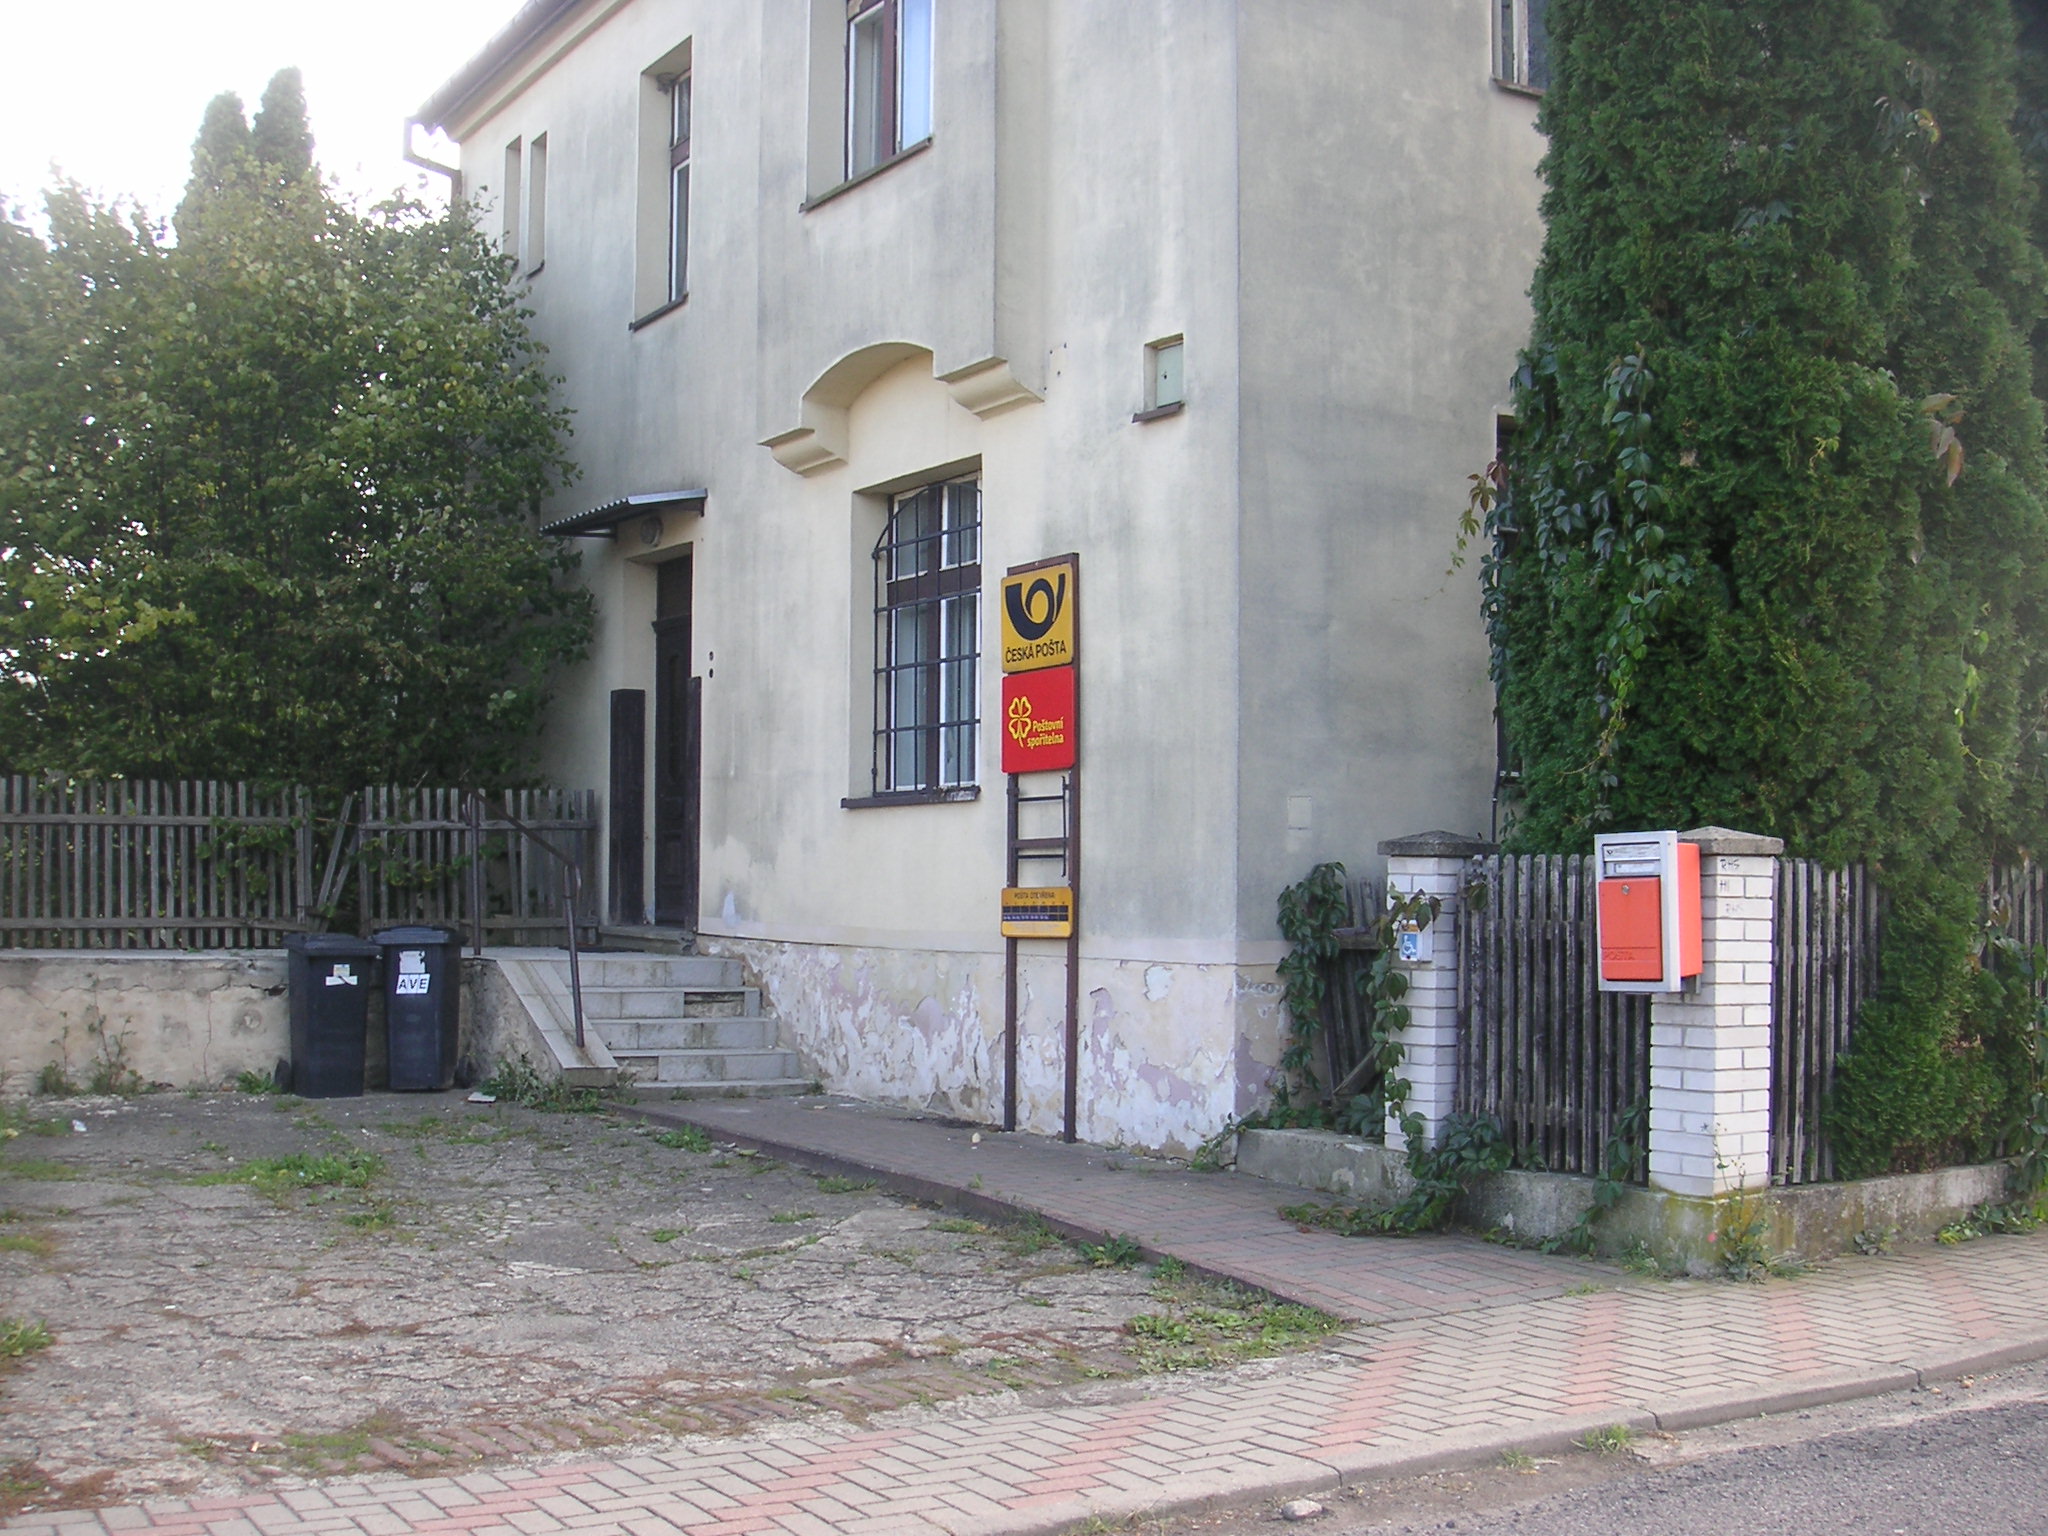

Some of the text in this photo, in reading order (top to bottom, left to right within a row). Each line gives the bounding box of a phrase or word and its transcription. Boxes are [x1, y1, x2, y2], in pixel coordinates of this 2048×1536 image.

[1006, 639, 1067, 663] ČESKÁ POŠTA
[1032, 716, 1064, 732] Poštovní
[1027, 732, 1064, 749] spořitelna
[398, 978, 428, 989] AVE
